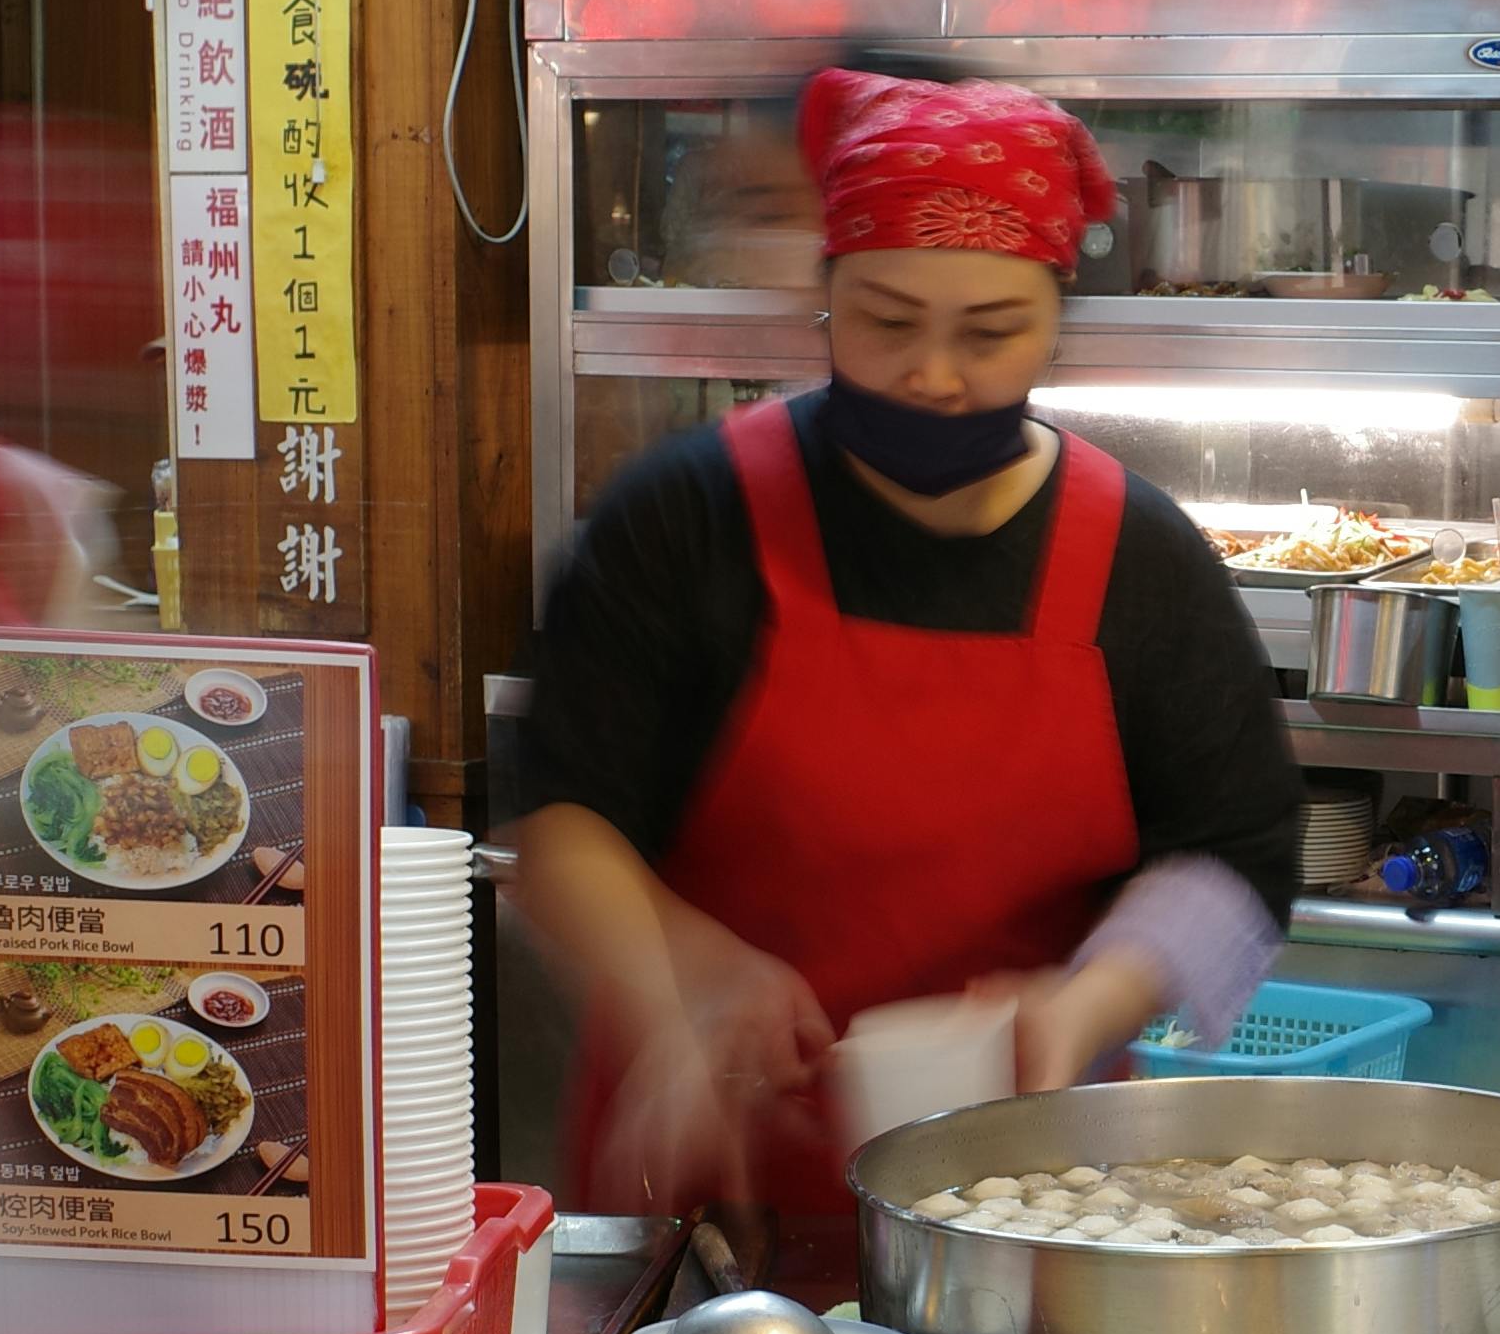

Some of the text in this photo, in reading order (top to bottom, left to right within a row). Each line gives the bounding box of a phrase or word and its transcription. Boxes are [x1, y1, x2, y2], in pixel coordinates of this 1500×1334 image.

[177, 32, 195, 152] Drinking
[205, 186, 242, 336] 福州丸
[277, 424, 342, 604] 謝謝
[40, 937, 69, 951] Pork
[72, 938, 99, 952] Rice
[102, 940, 134, 954] Bowl
[209, 922, 284, 957] 110
[0, 1192, 115, 1223] 焢肉便當
[2, 1222, 172, 1243] Soy-Stewed Pork Rice Bowl
[215, 1211, 291, 1245] 150
